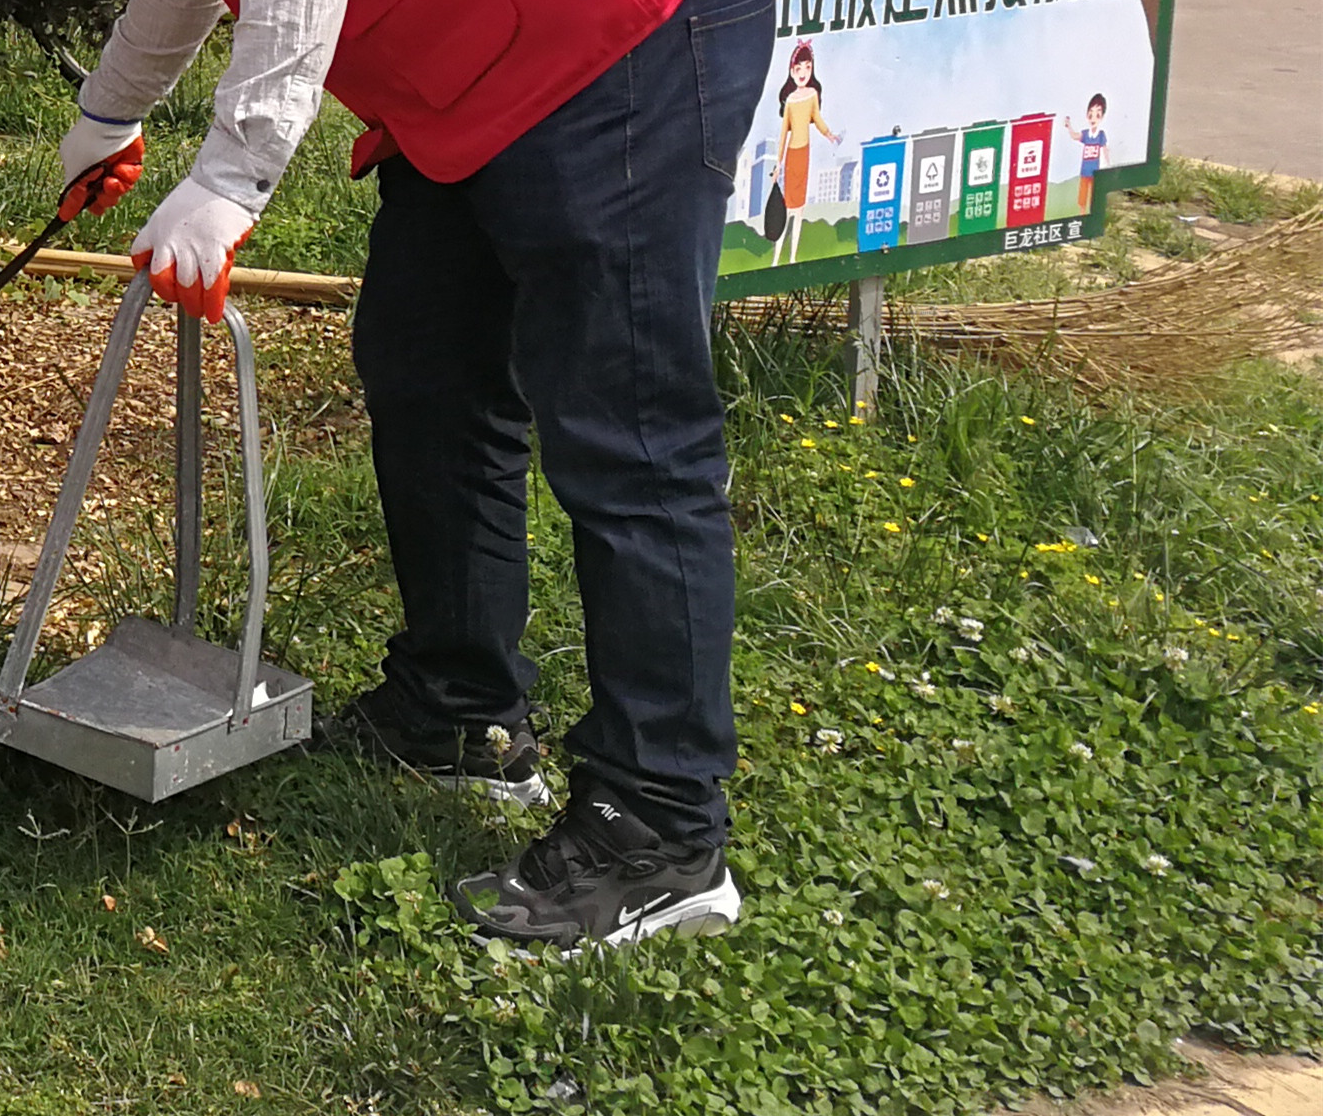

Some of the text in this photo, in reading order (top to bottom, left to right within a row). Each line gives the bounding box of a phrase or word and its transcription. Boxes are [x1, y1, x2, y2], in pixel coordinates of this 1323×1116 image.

[1004, 220, 1083, 250] 巨龙社区 宣
